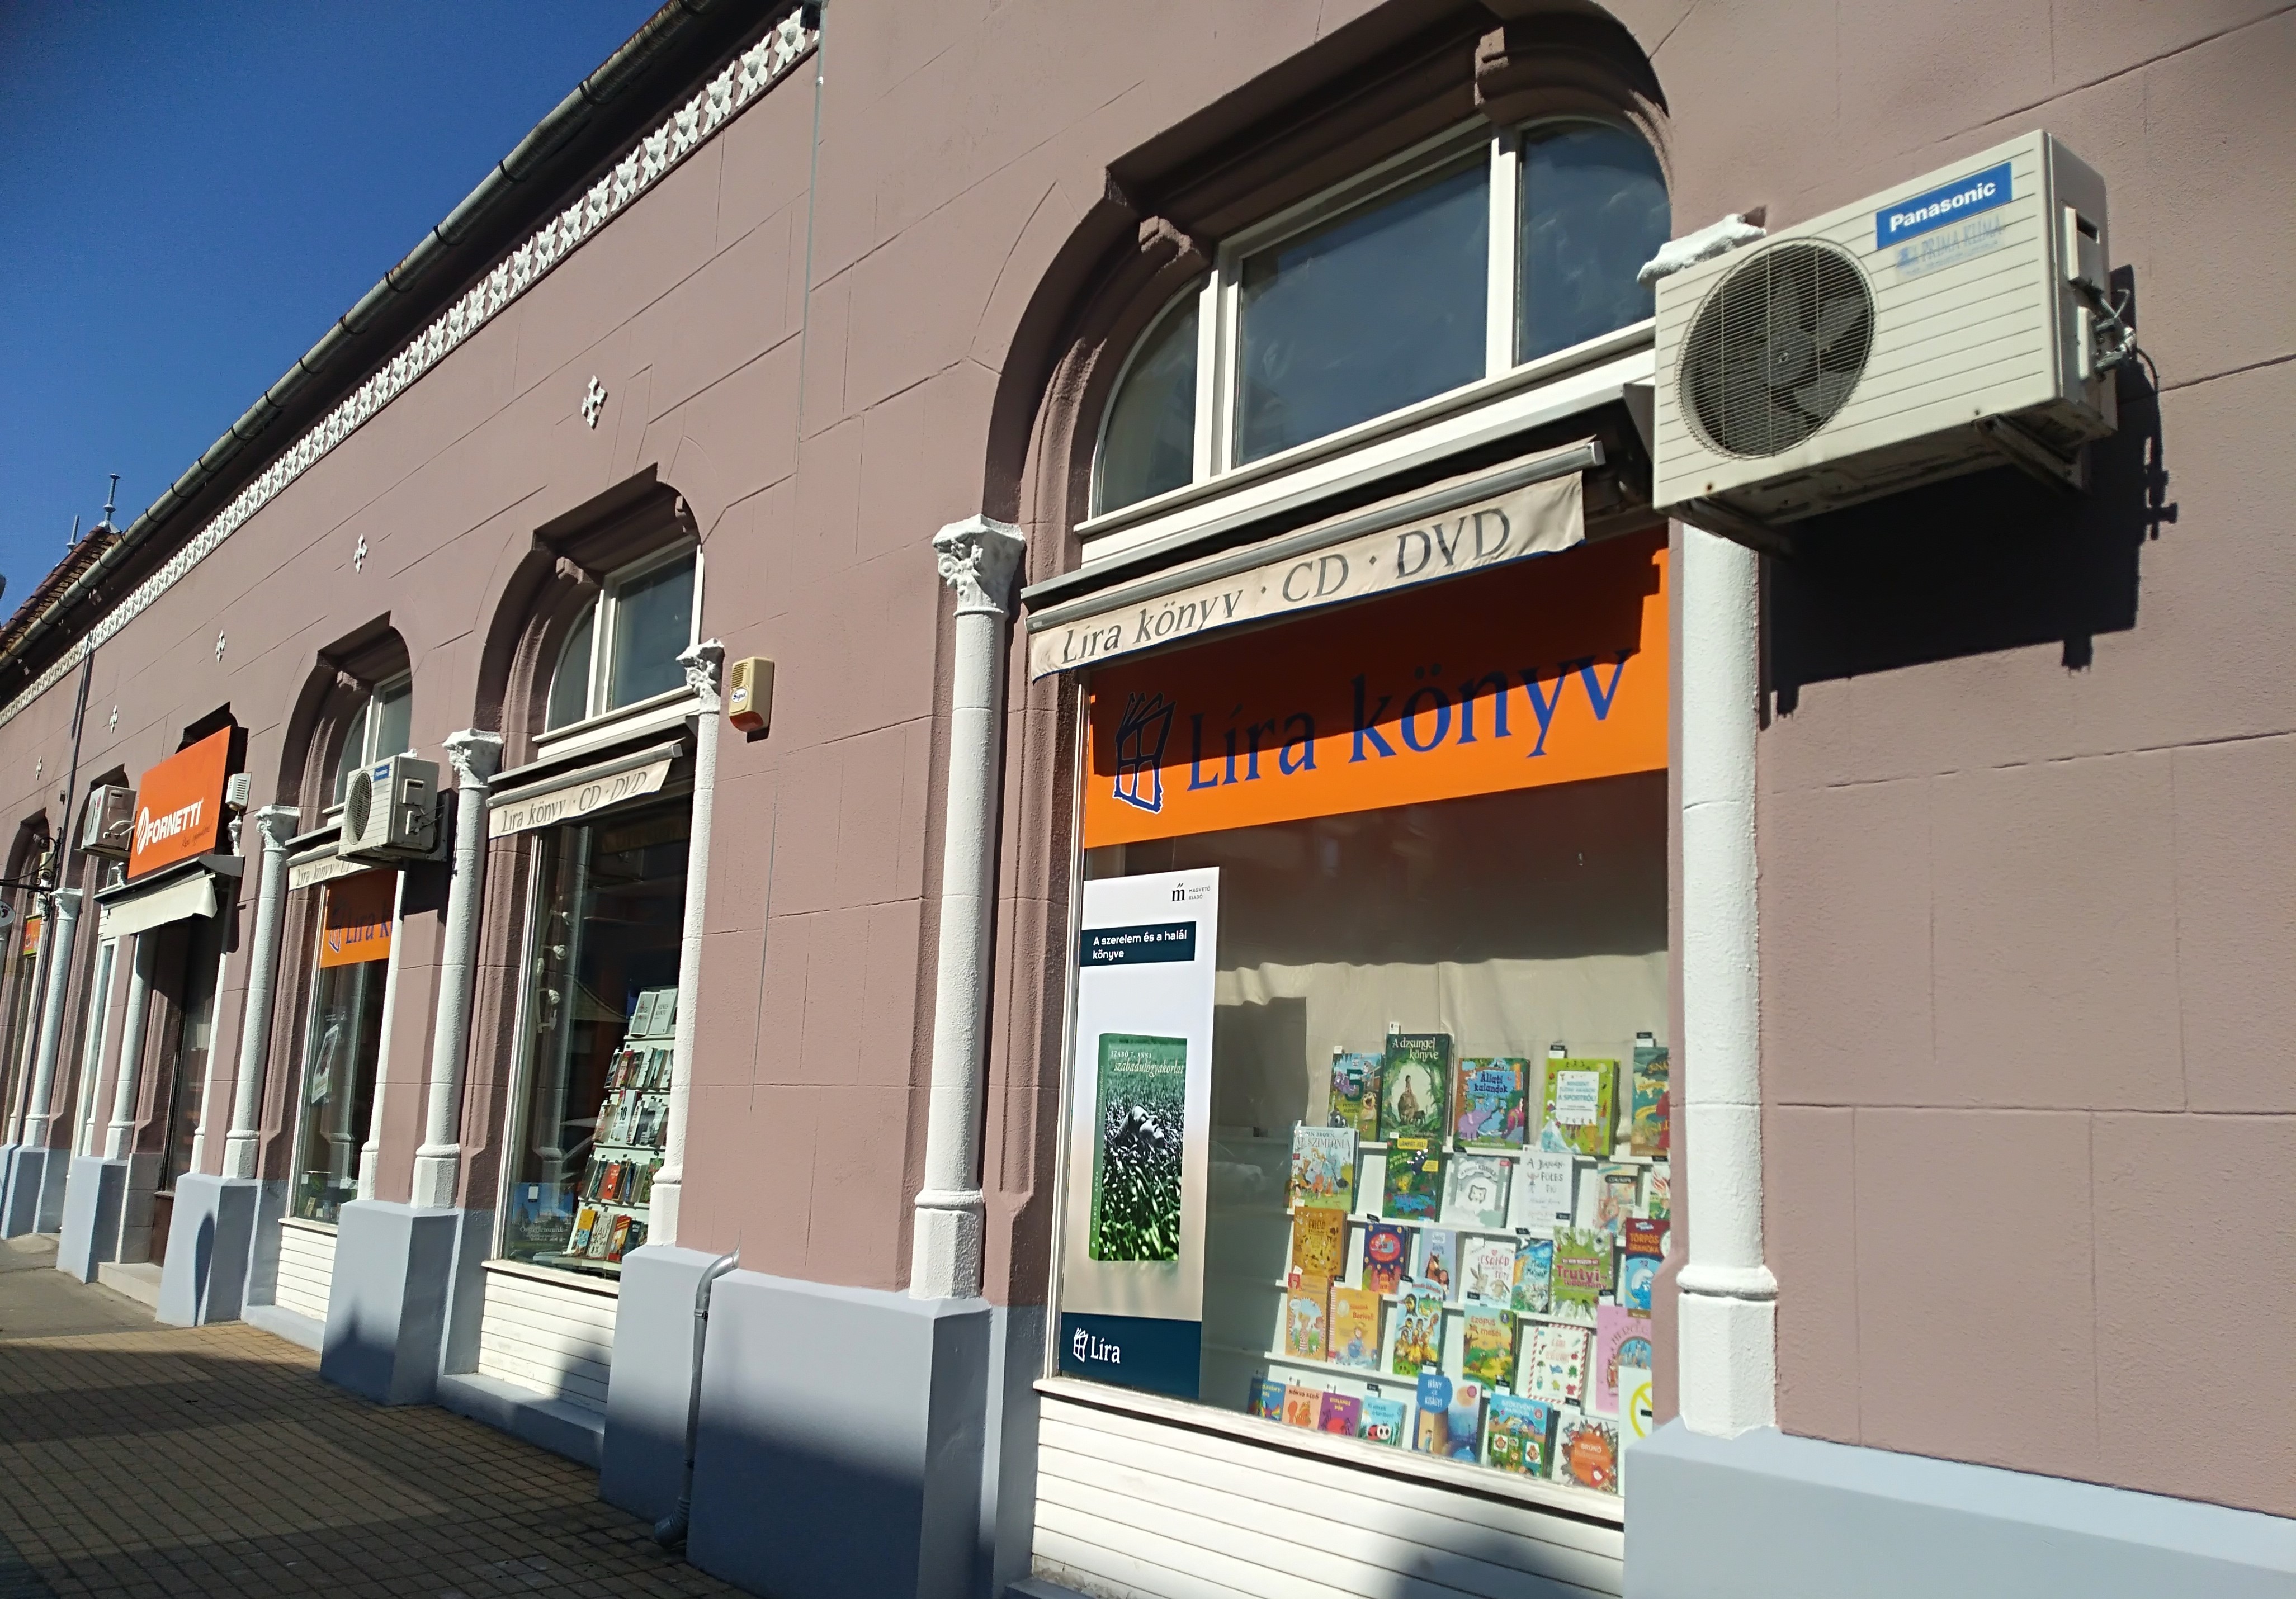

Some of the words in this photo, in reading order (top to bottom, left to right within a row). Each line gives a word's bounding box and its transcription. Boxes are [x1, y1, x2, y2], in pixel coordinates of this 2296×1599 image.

[1889, 181, 1996, 233] Panasonic
[1061, 624, 1121, 664] Líra
[1133, 590, 1242, 644] könyv
[1282, 554, 1349, 603] CD
[1395, 508, 1511, 579] DVD
[1187, 703, 1318, 792] Líra
[1348, 647, 1634, 764] könyv
[527, 798, 567, 825] könyv
[579, 785, 601, 811] CD
[610, 771, 648, 801] DVD
[145, 800, 202, 846] FORNETTI
[1093, 936, 1100, 946] A
[1101, 933, 1141, 946] szerelem
[1144, 931, 1154, 943] és
[1164, 929, 1187, 940] halál
[1093, 948, 1125, 961] könyve
[1392, 1038, 1399, 1048] A
[1400, 1037, 1436, 1051] dzsungel
[1409, 1048, 1439, 1062] könyve
[1114, 1057, 1184, 1077] szabadulógyakorlat
[1473, 1083, 1508, 1094] kalandok
[1090, 1336, 1121, 1364] Líra
